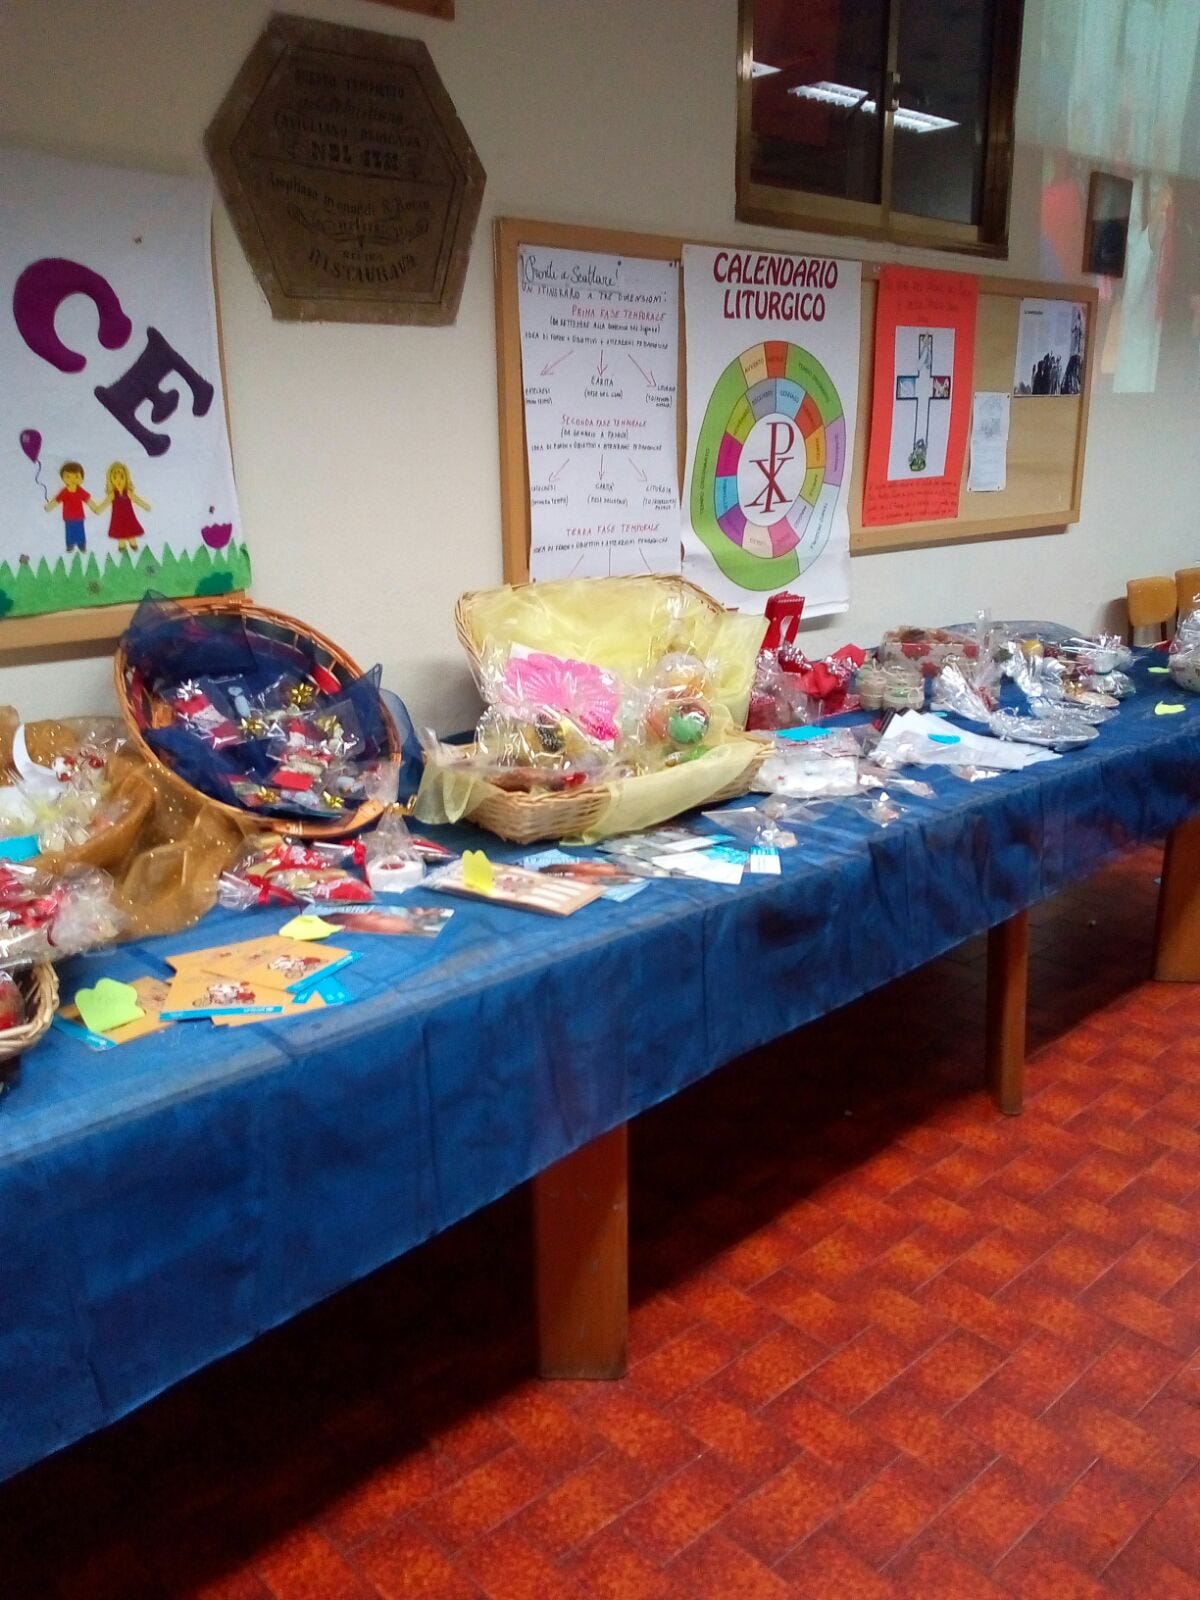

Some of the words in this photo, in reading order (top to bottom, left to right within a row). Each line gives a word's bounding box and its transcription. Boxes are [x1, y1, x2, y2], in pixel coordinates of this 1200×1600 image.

[713, 252, 838, 289] CALENDARIO
[572, 303, 595, 318] PRIMA
[600, 307, 620, 320] FASE
[624, 308, 667, 323] TEMPORALE
[724, 289, 826, 321] LITURGICO
[597, 524, 616, 534] FASE
